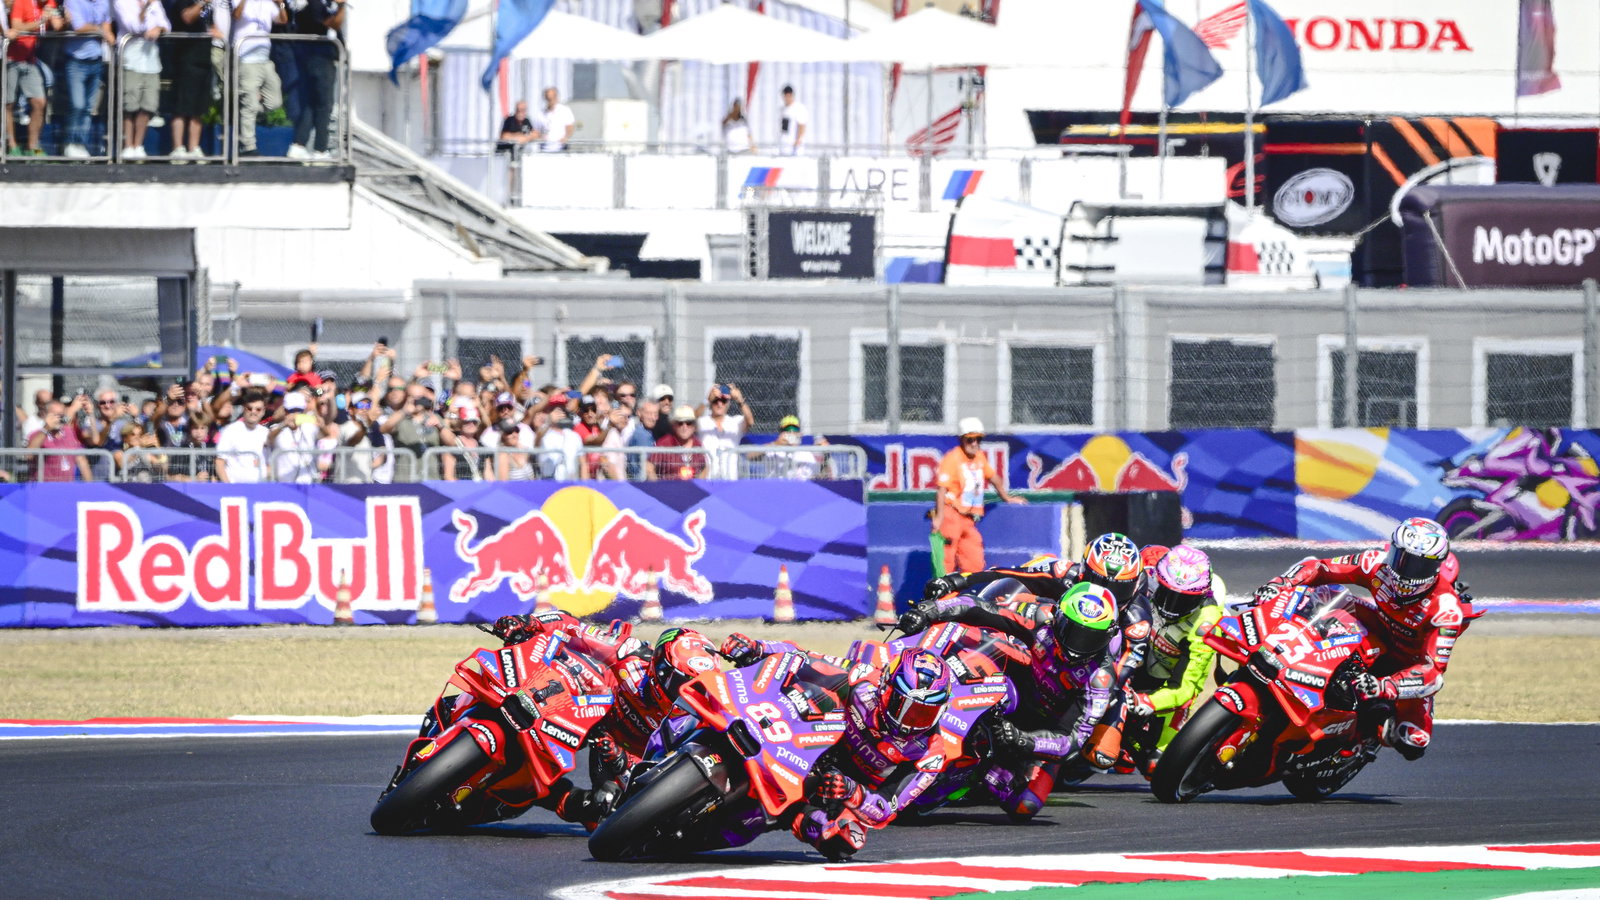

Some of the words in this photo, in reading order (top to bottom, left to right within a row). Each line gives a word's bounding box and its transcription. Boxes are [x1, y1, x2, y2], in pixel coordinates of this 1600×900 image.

[791, 221, 852, 255] WELCOME
[79, 498, 247, 610] Red
[256, 497, 420, 609] Bull
[1242, 611, 1258, 646] Lenovo
[1265, 623, 1314, 664] 23
[500, 648, 517, 688] Lenovo
[757, 656, 778, 689] PRAMAC
[1285, 668, 1325, 687] Lenovo
[729, 669, 749, 704] prima
[958, 696, 995, 706] PRAMAC
[1218, 686, 1243, 711] Lenovo
[540, 721, 579, 747] Lenovo
[745, 702, 793, 743] 89
[942, 712, 968, 731] rima
[472, 722, 496, 753] Lenovo
[798, 734, 835, 745] PRAMAC
[776, 746, 810, 770] prima
[770, 762, 800, 786] MOTUL
